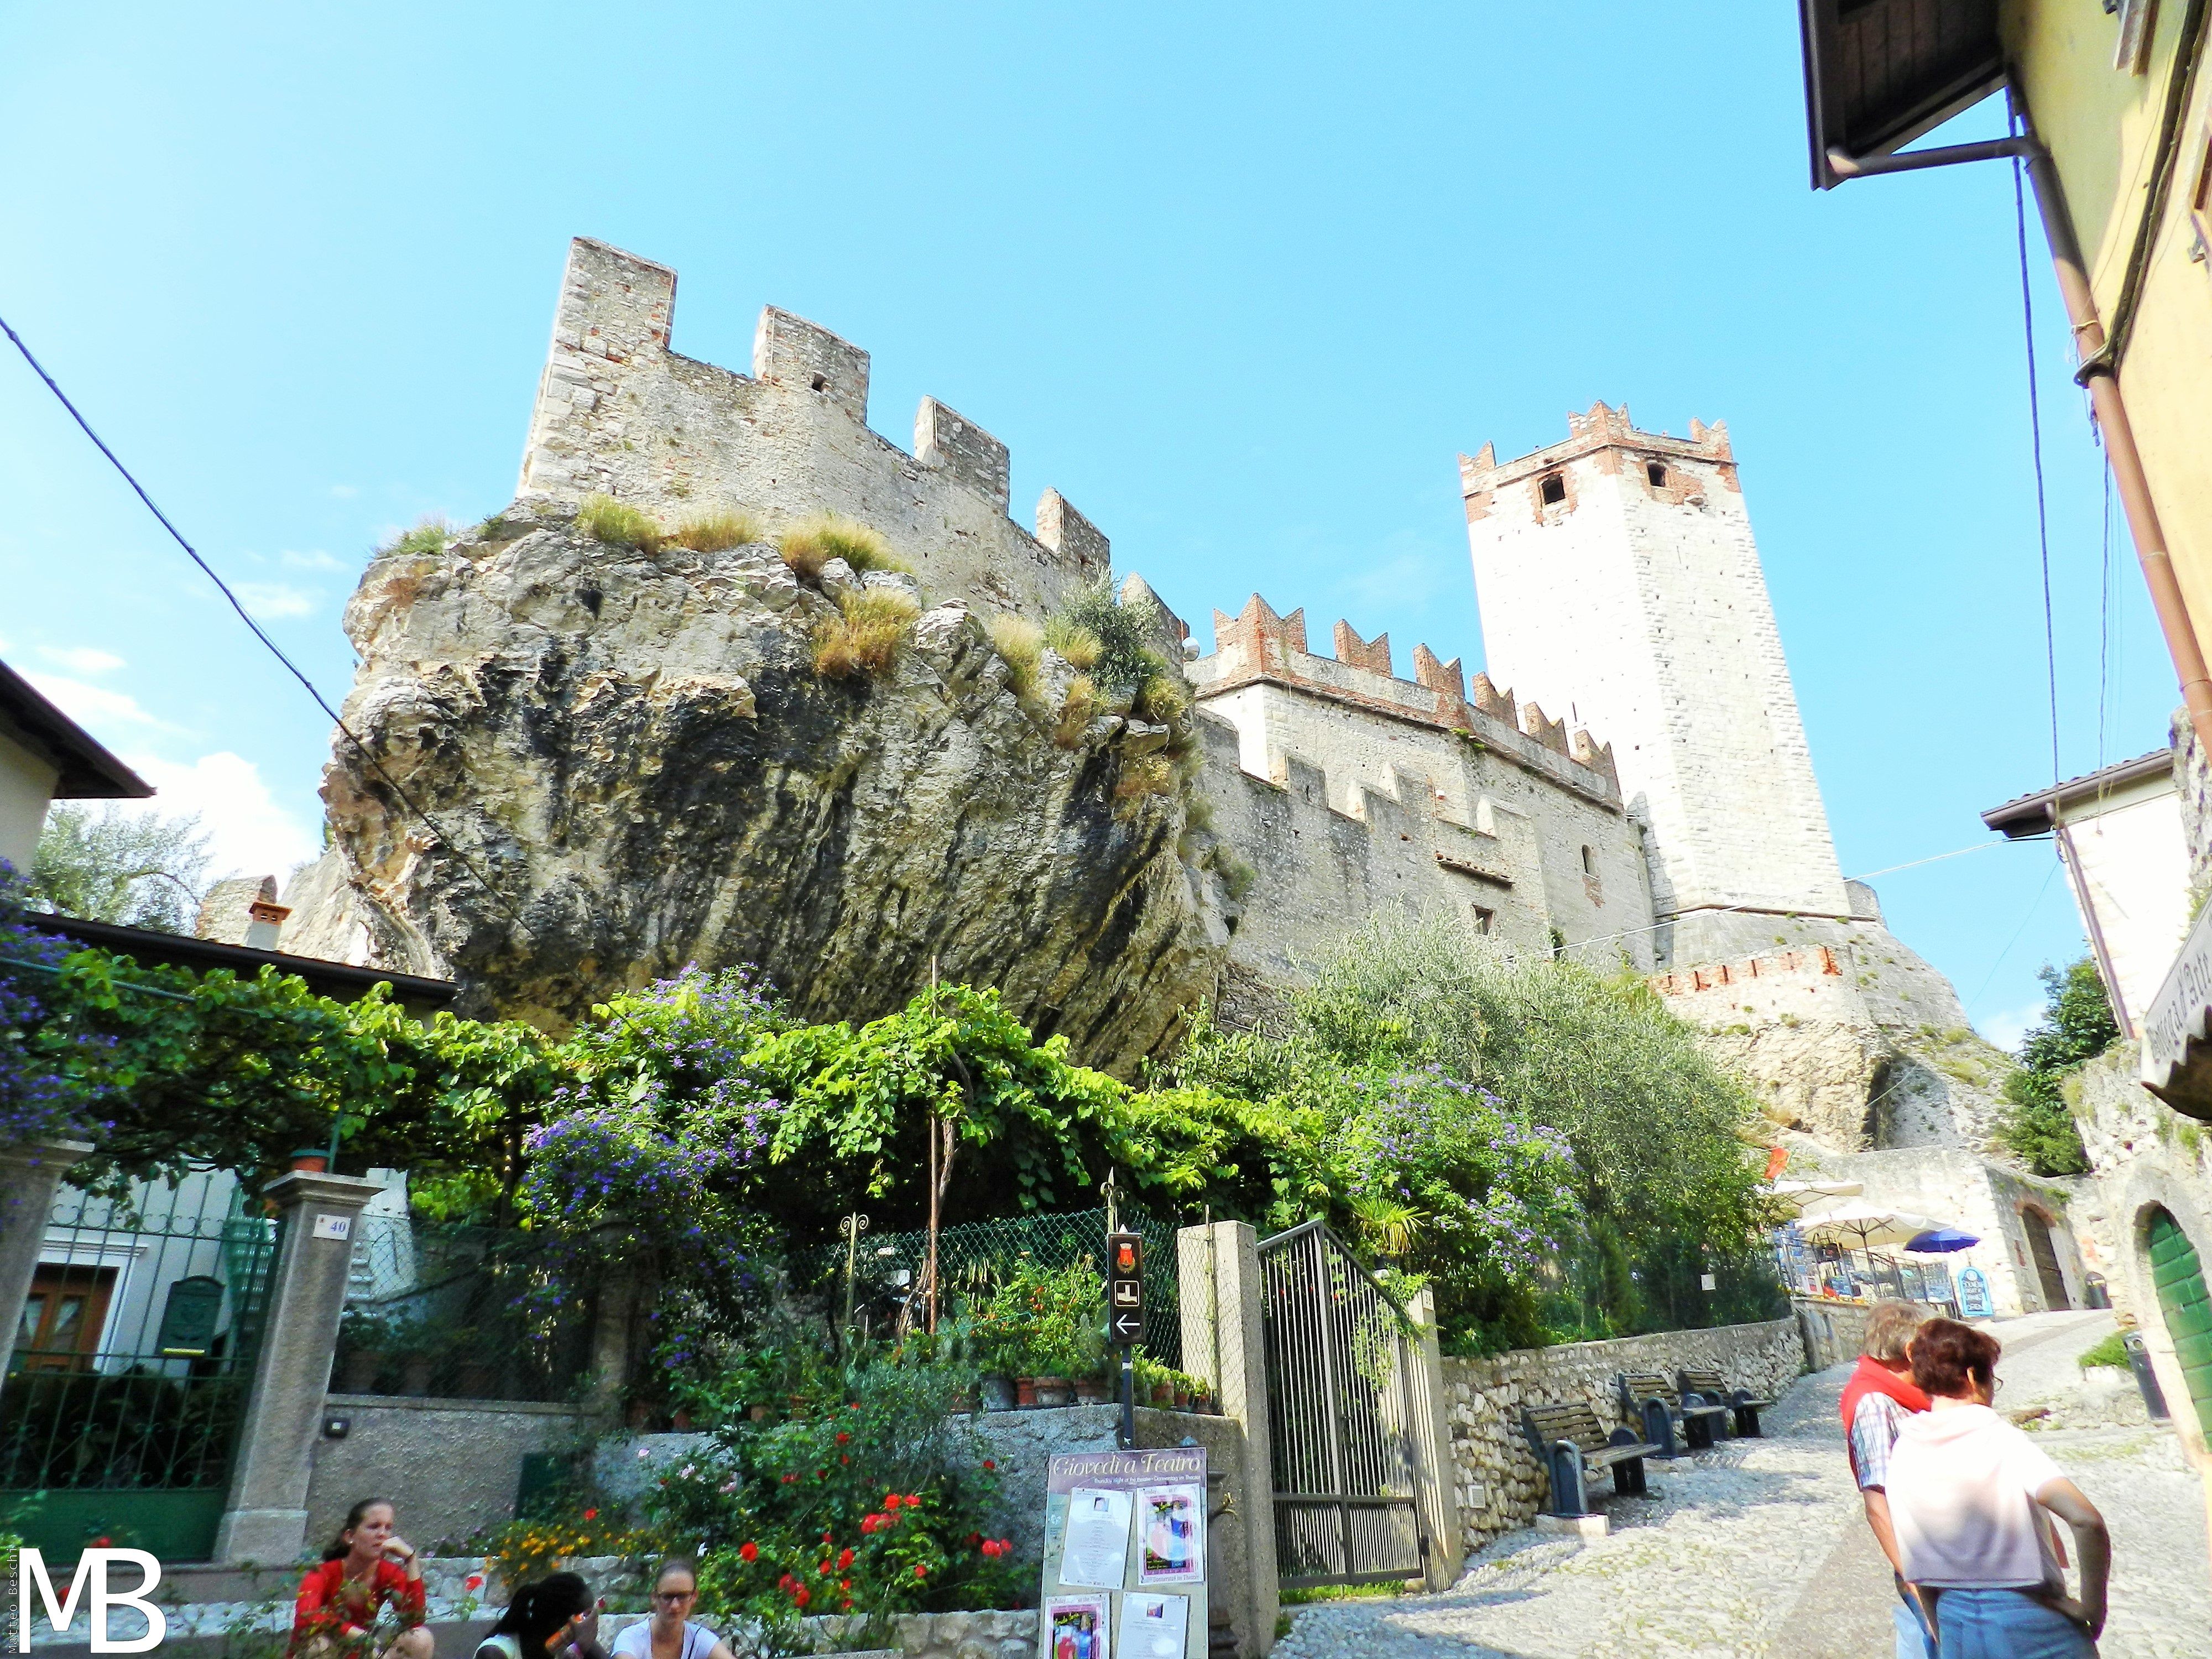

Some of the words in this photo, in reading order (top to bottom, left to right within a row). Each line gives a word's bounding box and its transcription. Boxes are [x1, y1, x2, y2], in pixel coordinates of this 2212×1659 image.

[330, 1221, 346, 1233] 40
[1053, 1454, 1121, 1476] Giovedì
[1124, 1460, 1136, 1474] a
[1141, 1452, 1201, 1474] Teatro
